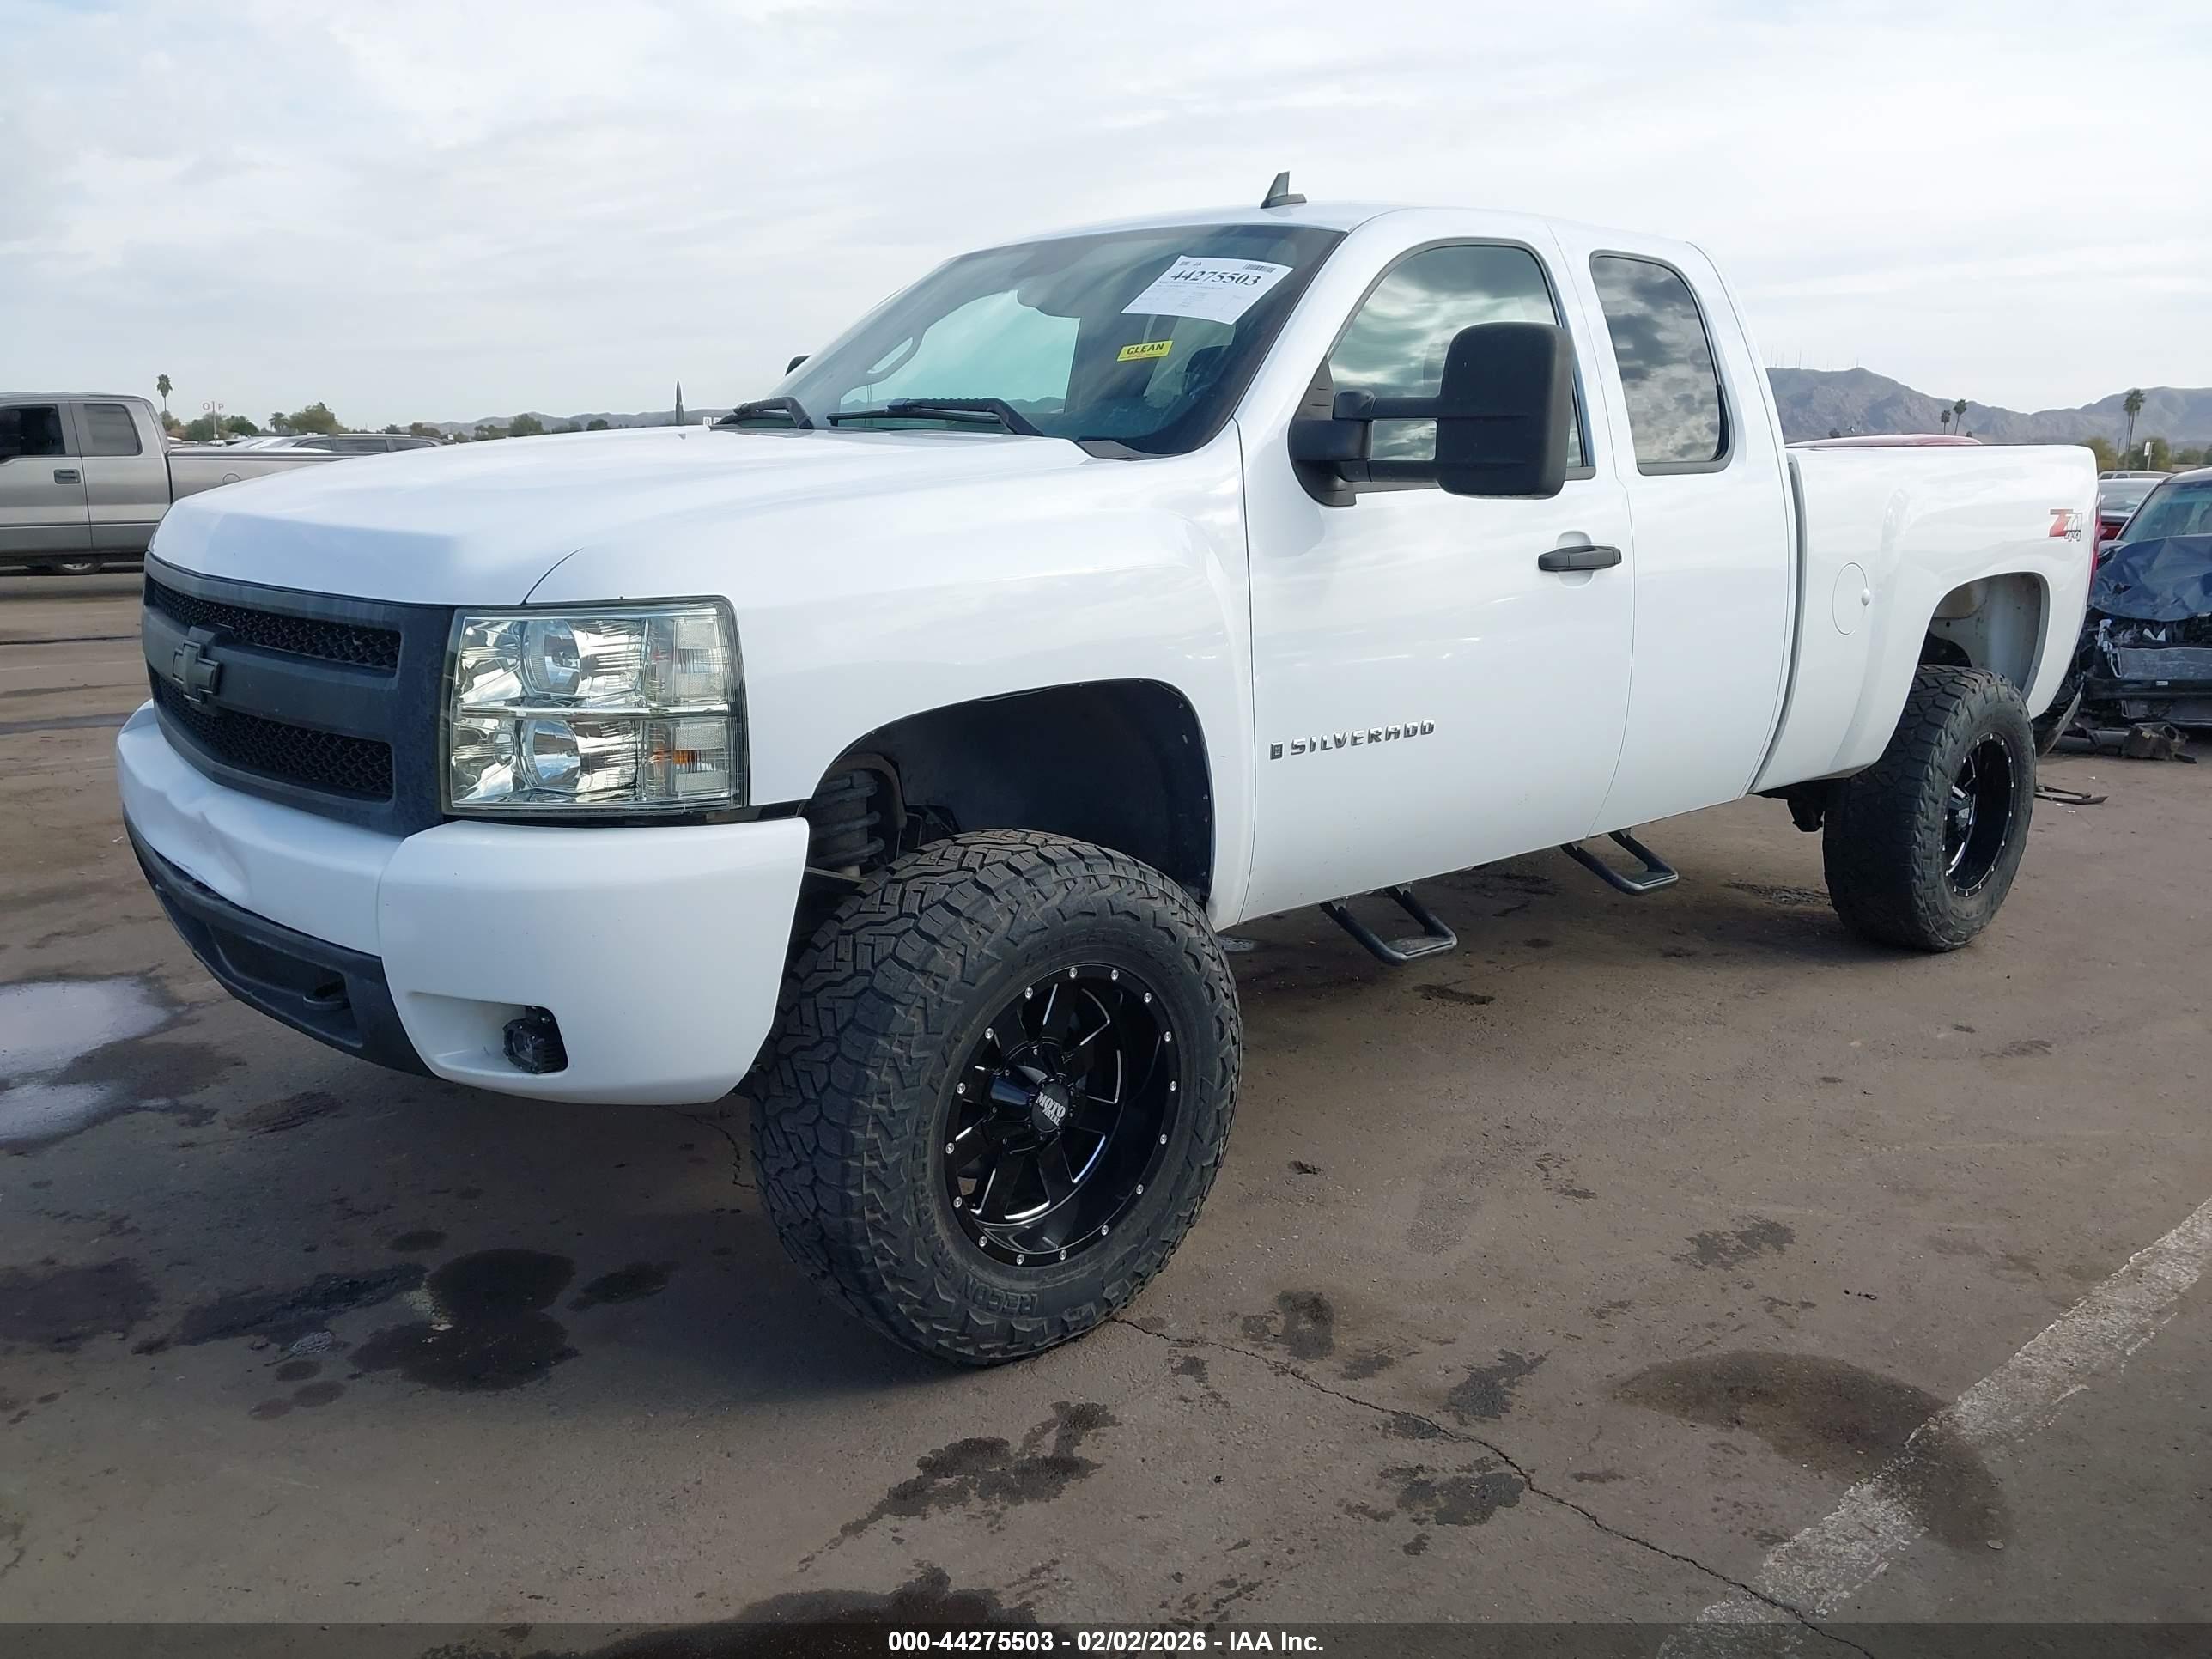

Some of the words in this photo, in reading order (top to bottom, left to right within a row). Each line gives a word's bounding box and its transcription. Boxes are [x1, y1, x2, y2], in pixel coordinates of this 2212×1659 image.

[1171, 270, 1262, 286] 44275503
[1126, 343, 1164, 355] CLEAN
[2049, 508, 2083, 538] Z71
[1290, 719, 1435, 756] SILVERADO
[1036, 1091, 1066, 1118] MOTO
[1042, 1108, 1061, 1127] METAL
